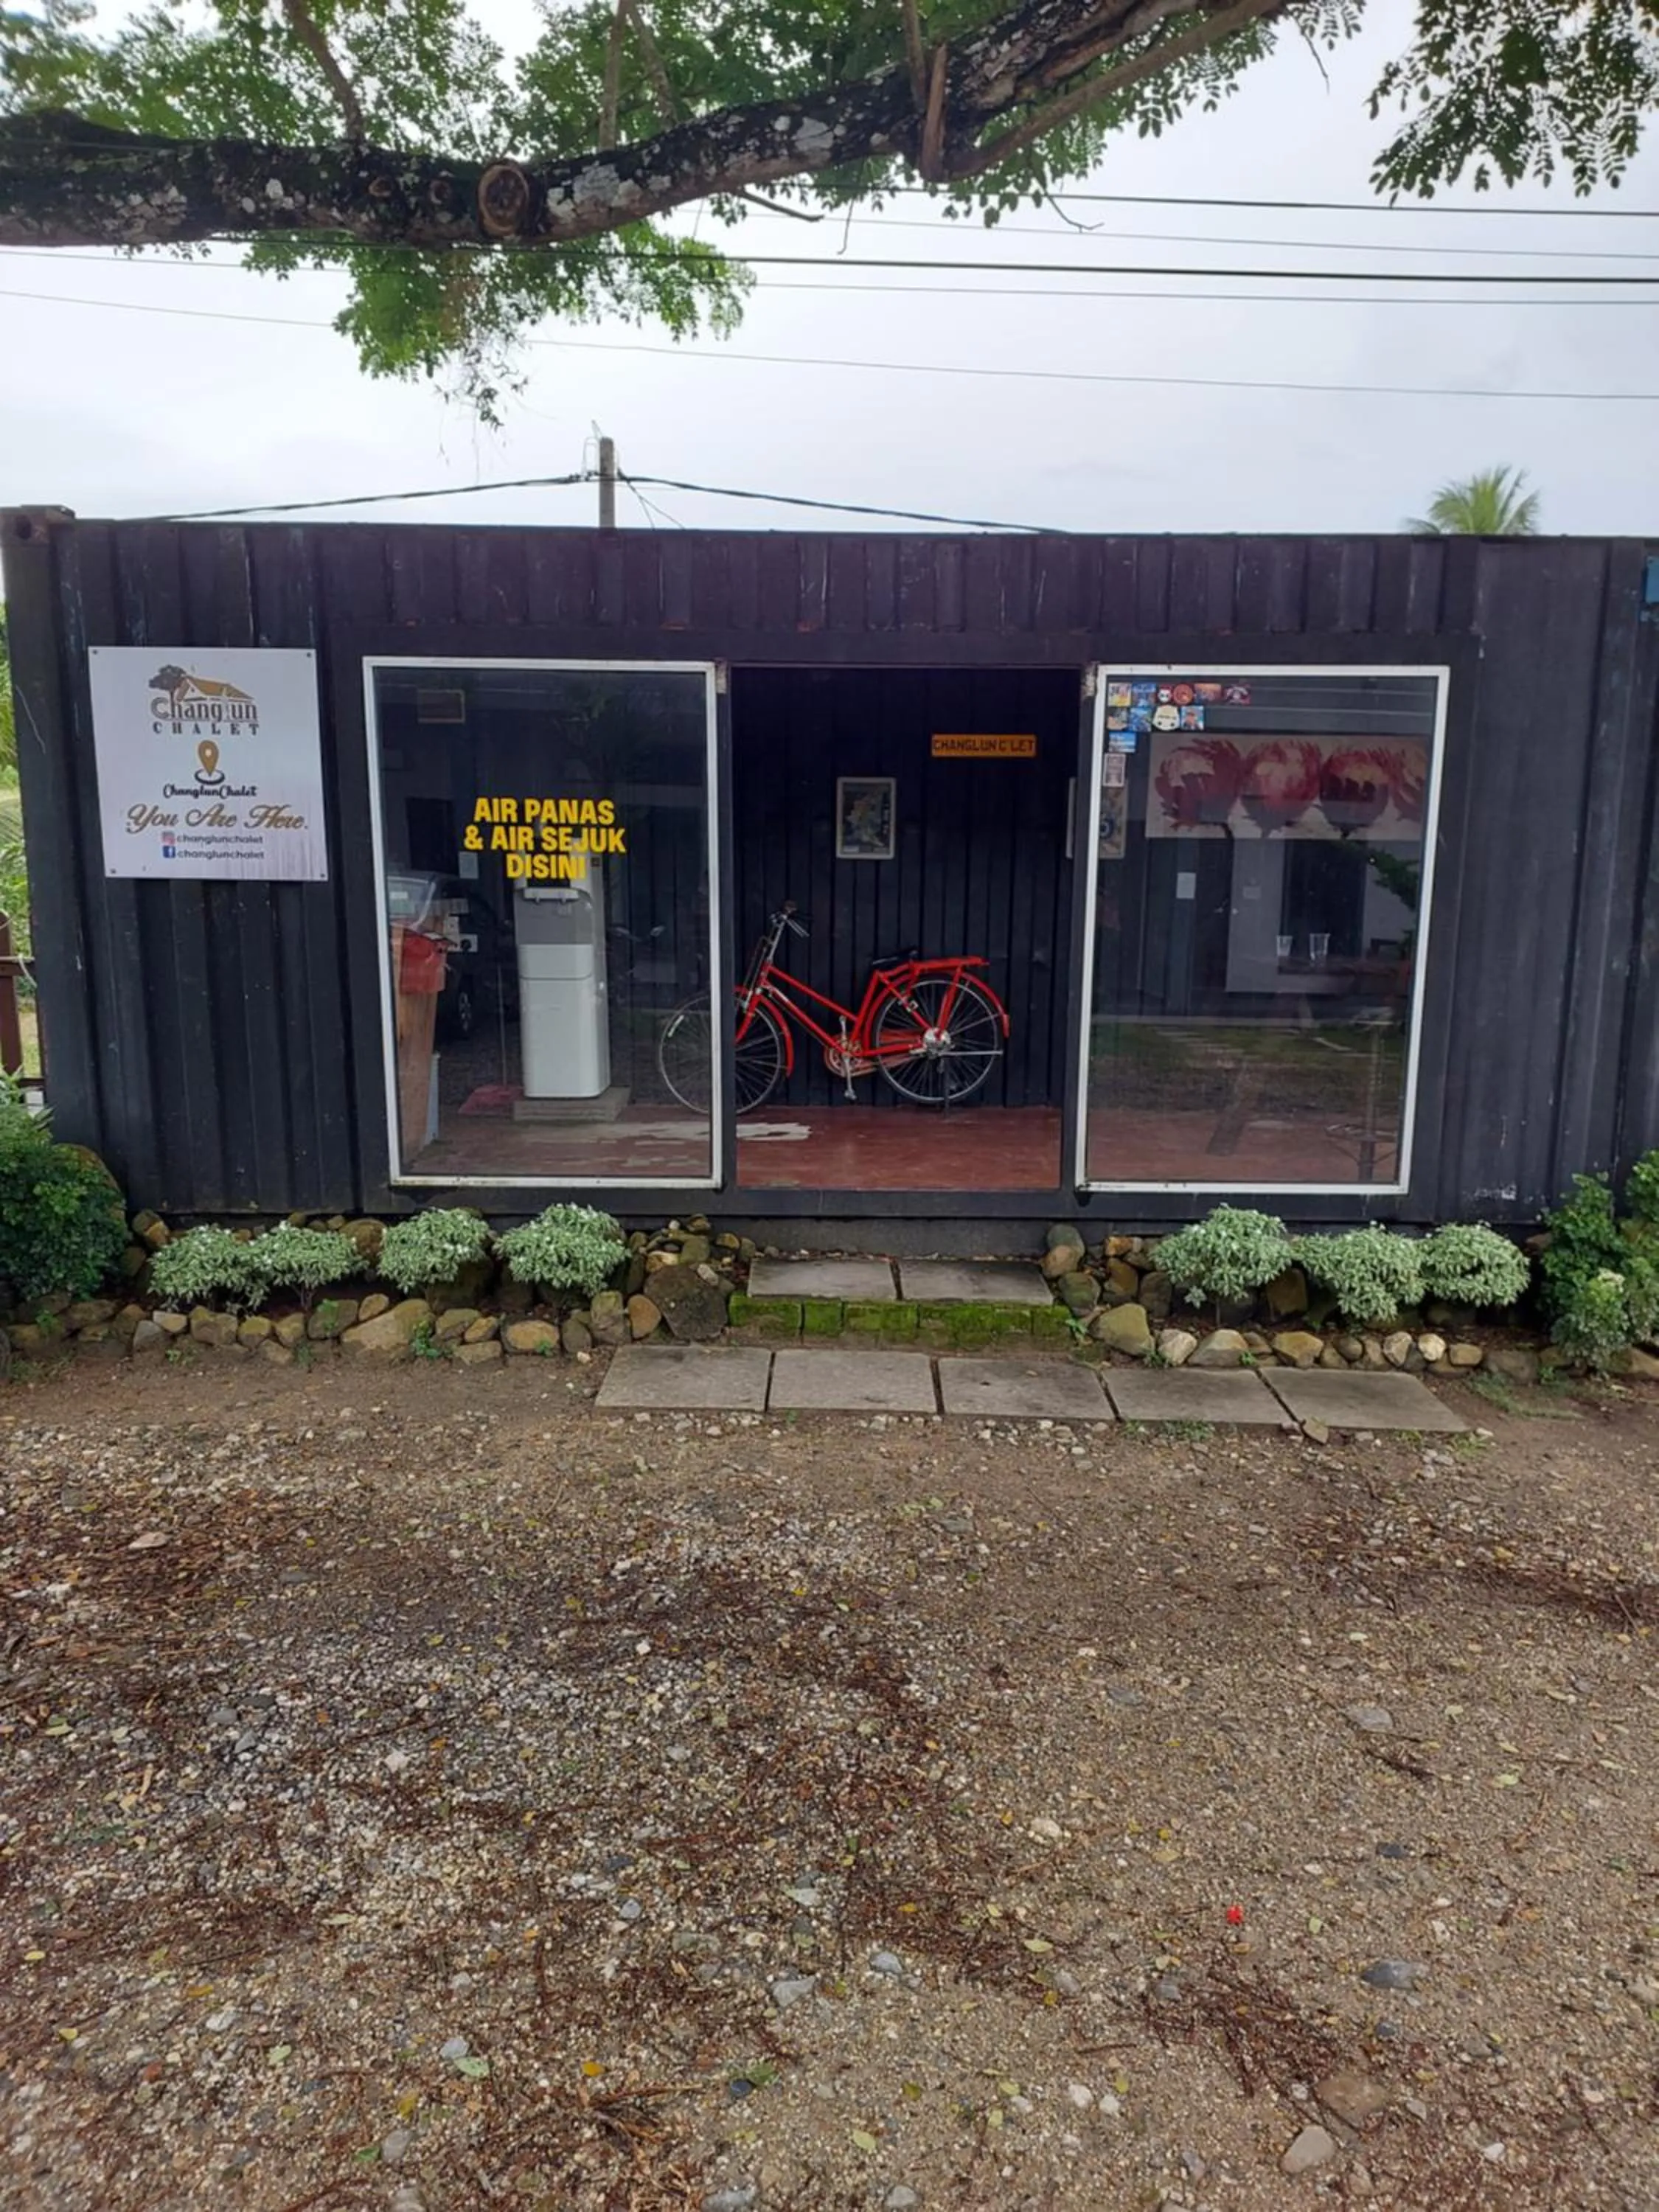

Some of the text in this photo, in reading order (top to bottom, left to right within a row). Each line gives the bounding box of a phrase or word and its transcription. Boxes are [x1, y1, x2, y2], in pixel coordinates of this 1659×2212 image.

[152, 721, 260, 736] CHALET
[125, 803, 178, 834] You
[185, 803, 237, 827] Are
[473, 797, 615, 825] AIR PANAS
[177, 835, 263, 844] changlunchalet
[464, 824, 627, 853] & AIR SEJUK
[177, 849, 264, 860] changlunchalet
[506, 853, 586, 879] DISINI
